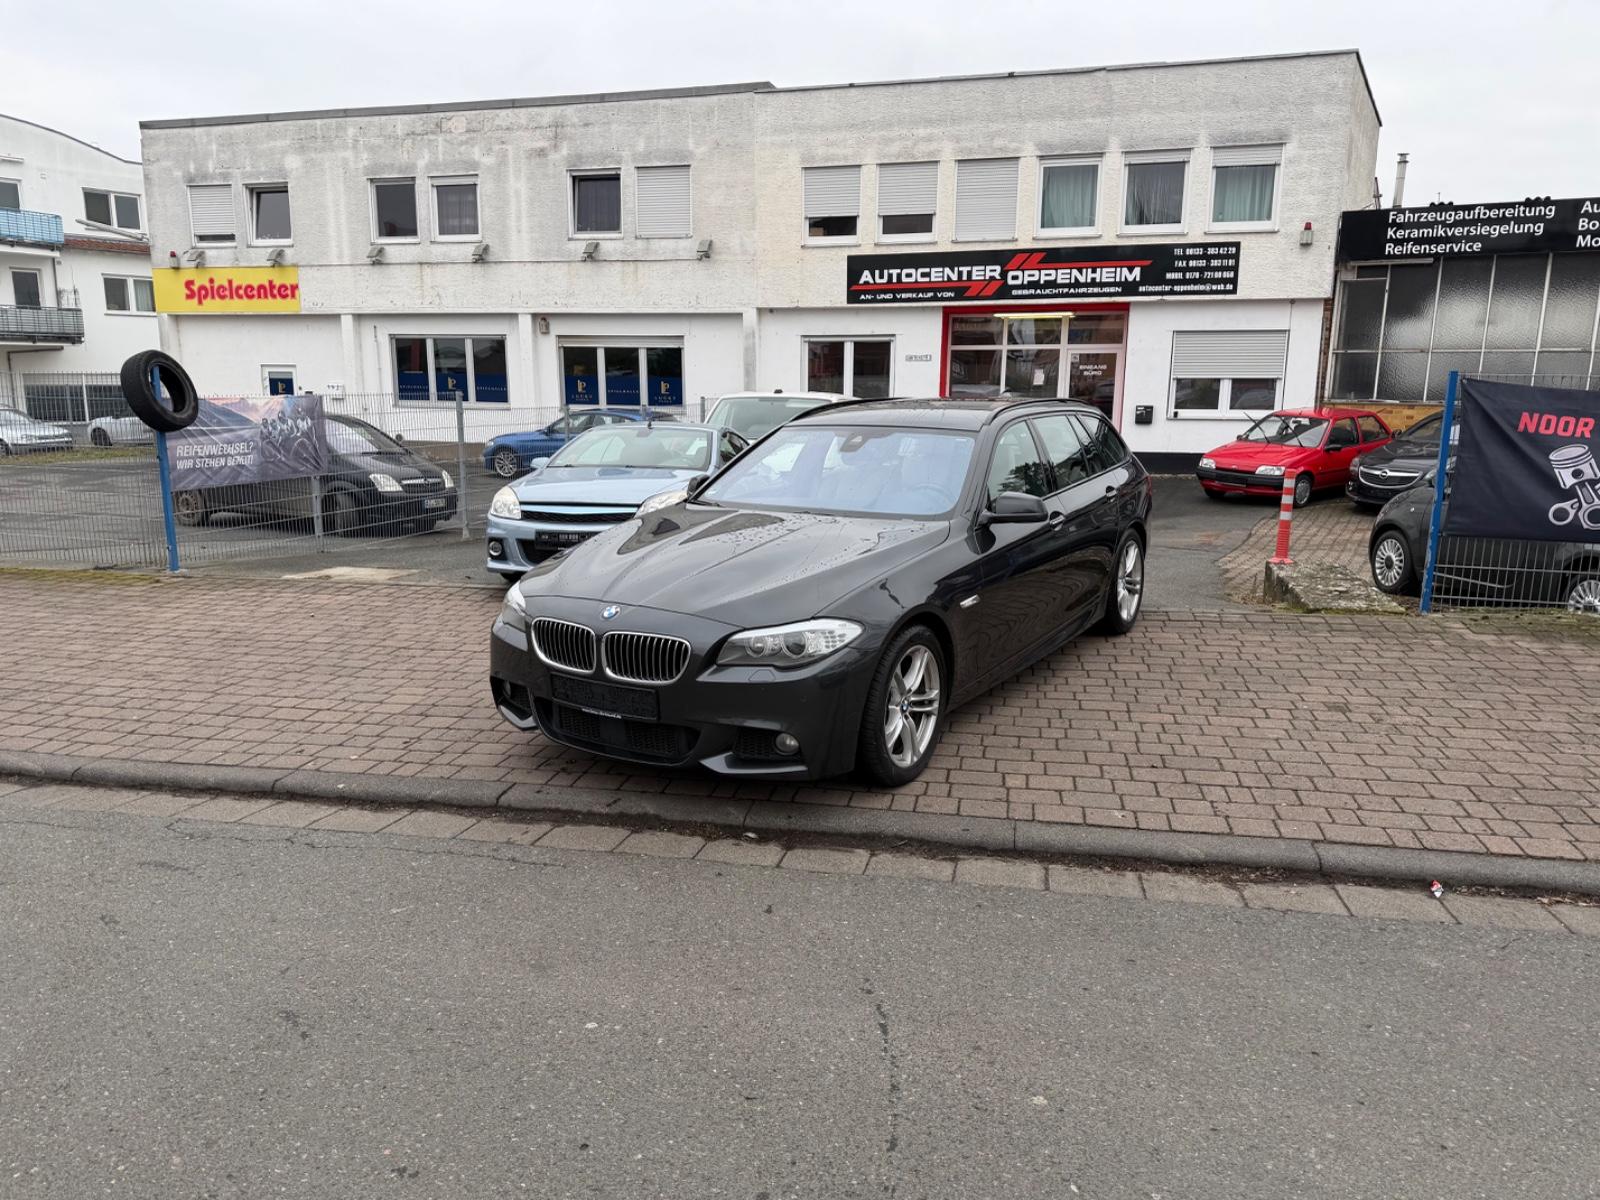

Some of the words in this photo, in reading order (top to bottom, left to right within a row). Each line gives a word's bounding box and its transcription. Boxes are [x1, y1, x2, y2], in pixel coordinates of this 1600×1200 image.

[1388, 205, 1556, 223] Fahrzeugaufbereitung
[1386, 221, 1544, 239] Keramikversiegelung
[1578, 218, 1600, 231] Bo
[1384, 240, 1482, 255] Reifenservice
[859, 265, 1002, 284] AUTOCENTER
[1006, 266, 1142, 286] OPPENHEIM
[184, 277, 299, 306] Spielcenter
[1517, 411, 1596, 439] NOOR
[176, 459, 193, 470] WIR
[195, 456, 226, 469] STEHEN
